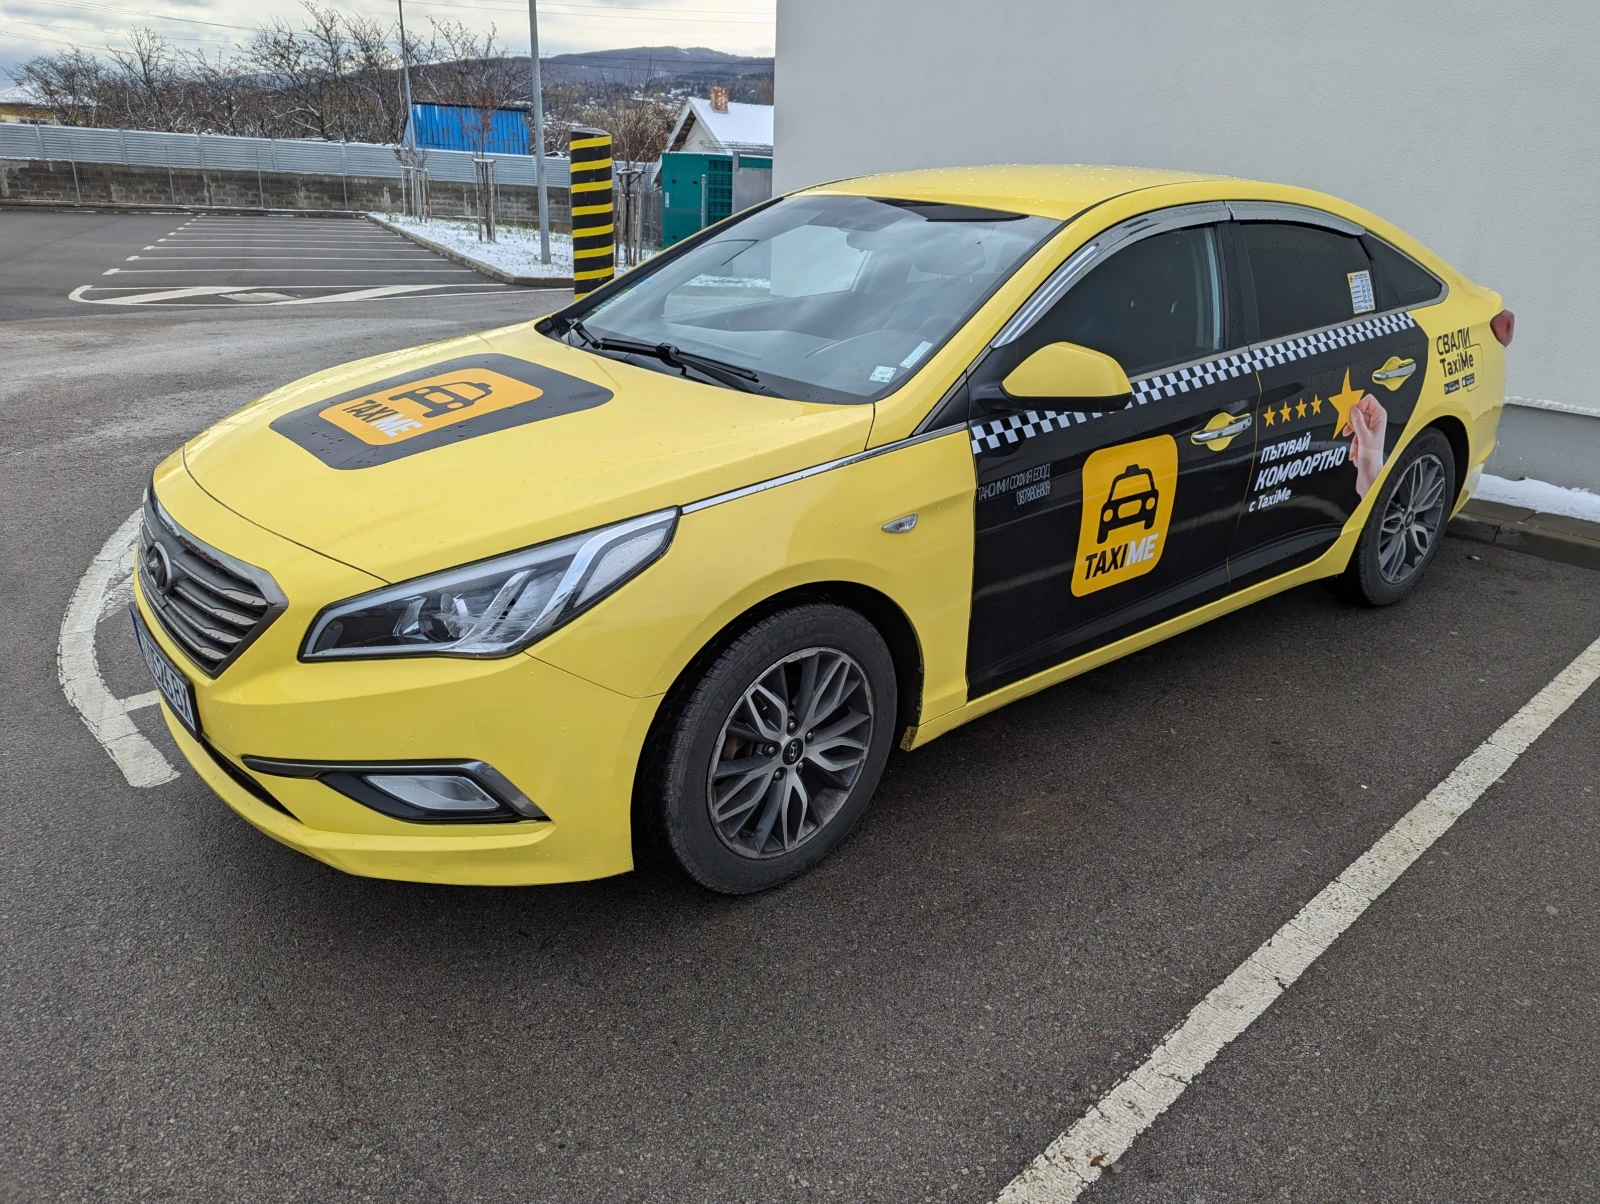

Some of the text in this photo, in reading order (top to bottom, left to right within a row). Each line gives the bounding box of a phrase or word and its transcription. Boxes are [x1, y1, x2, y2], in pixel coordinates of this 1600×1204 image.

[1436, 326, 1470, 356] СВАЛИ
[1439, 350, 1474, 378] TaxiMe
[342, 399, 424, 437] TAXIME
[1260, 431, 1312, 464] ПЪТУВАЙ
[1033, 463, 1051, 481] ЕООД
[1253, 445, 1347, 492] КОМФОРТНО
[1257, 486, 1292, 510] TaxiMe
[1084, 533, 1159, 581] TAXIME
